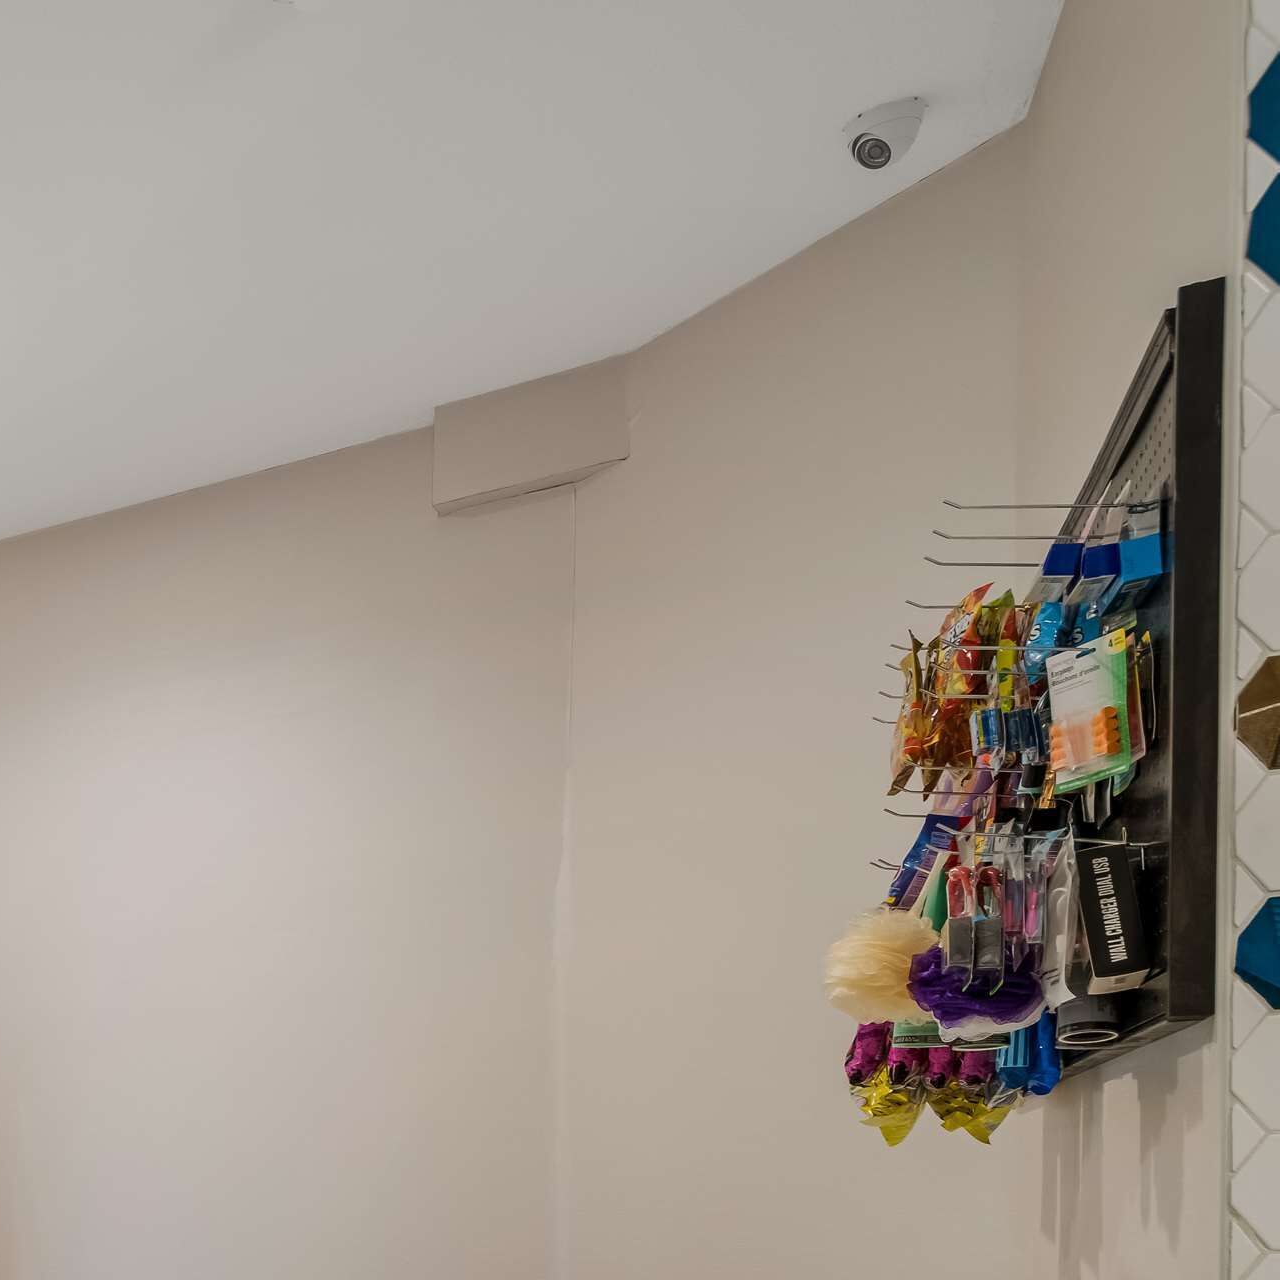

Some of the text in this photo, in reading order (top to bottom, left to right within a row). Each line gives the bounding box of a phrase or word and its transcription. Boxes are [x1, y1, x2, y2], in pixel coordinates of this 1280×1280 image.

[1092, 856, 1128, 963] WALL CHARGER DUAL USB
